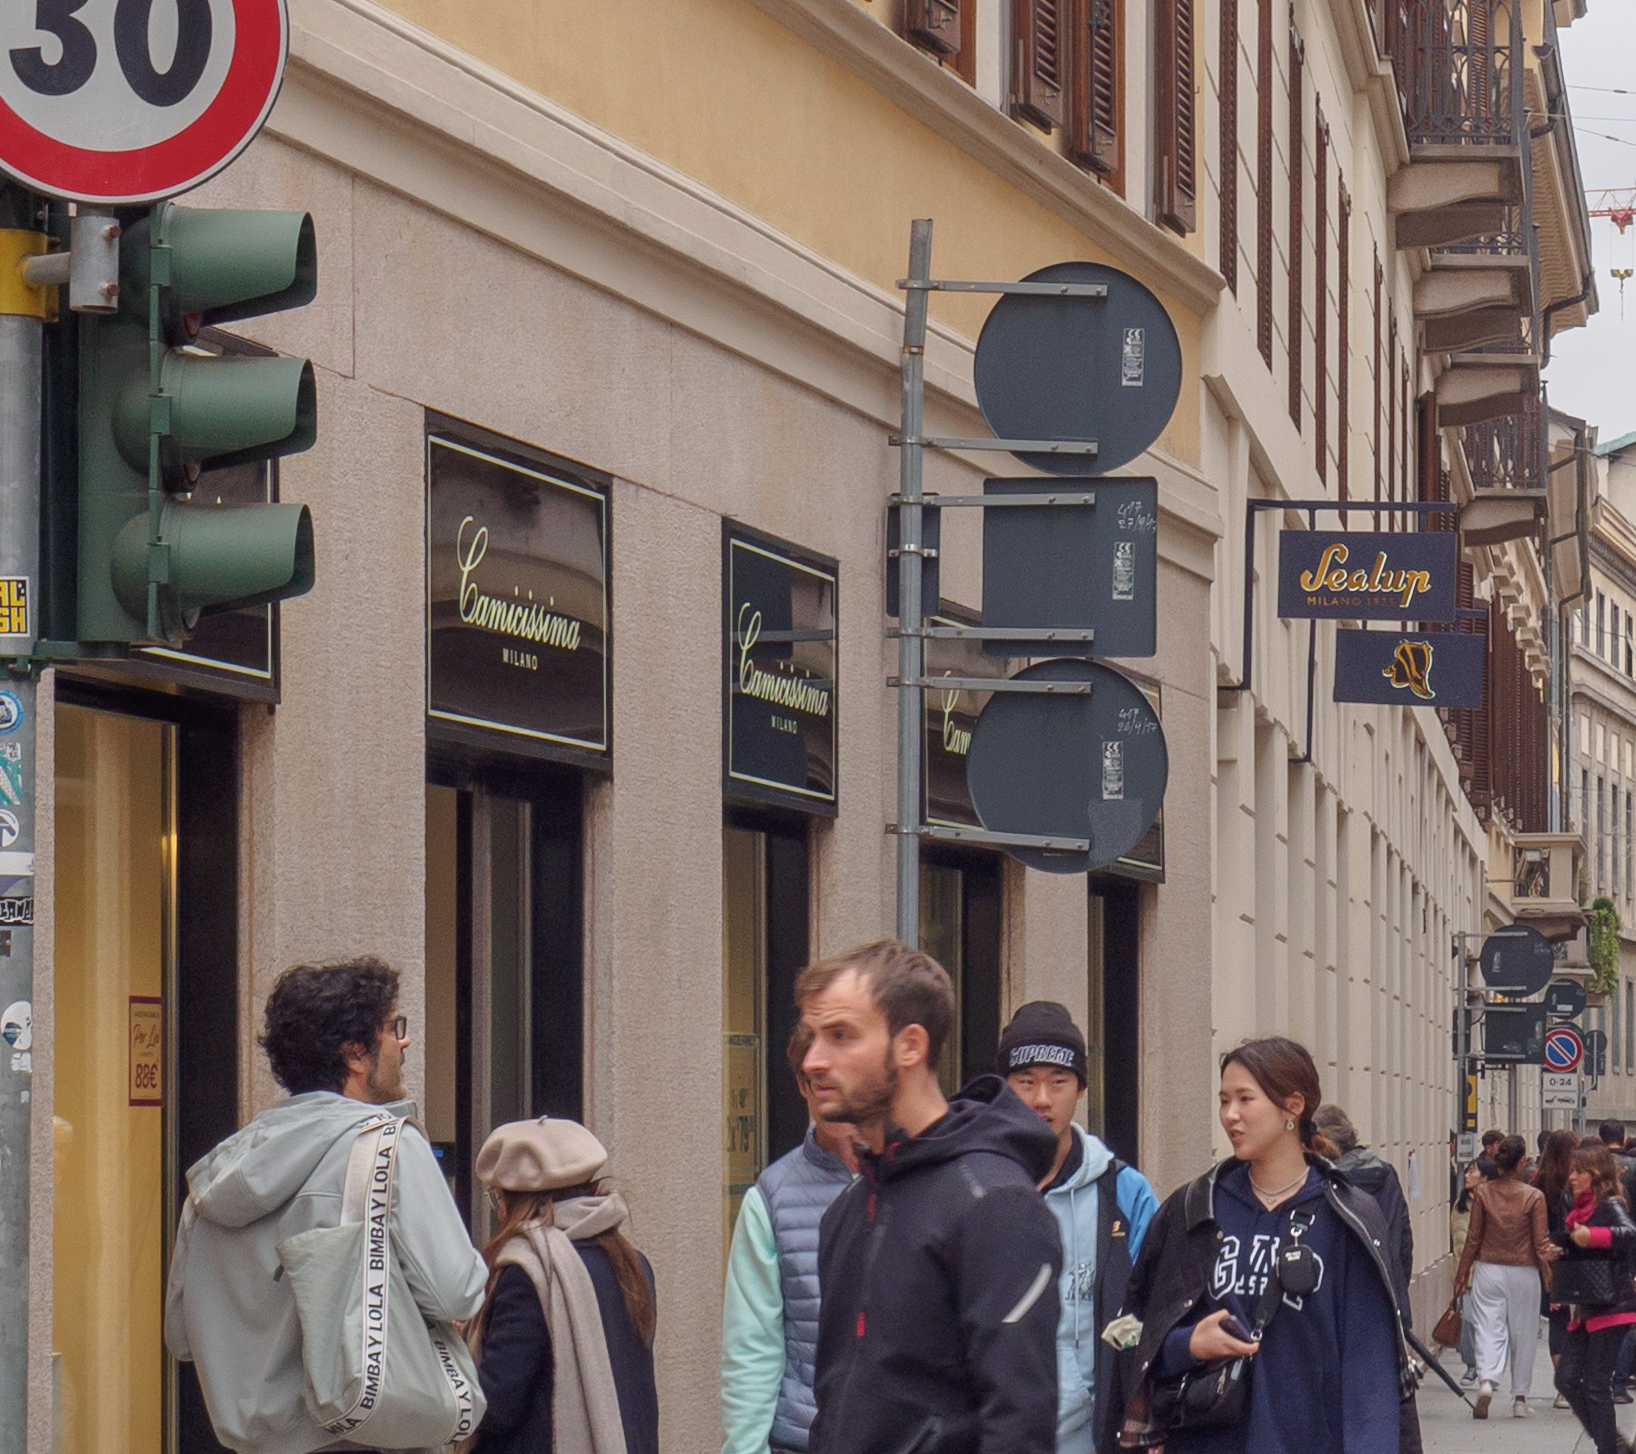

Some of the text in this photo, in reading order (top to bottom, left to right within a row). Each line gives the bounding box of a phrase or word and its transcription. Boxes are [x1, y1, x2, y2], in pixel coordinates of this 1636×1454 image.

[457, 516, 580, 650] Camicissima
[1300, 543, 1432, 608] Sealup
[1307, 597, 1362, 606] MILANO
[502, 648, 539, 670] MILANO
[738, 602, 829, 716] Camicissima
[771, 715, 798, 734] MILANO
[135, 1063, 159, 1089] 88€
[1009, 1045, 1075, 1066] SUPREME
[369, 1213, 387, 1271] BIMBA
[379, 1146, 393, 1194] LOLA
[368, 1283, 384, 1333] LOLA
[360, 1350, 383, 1410] BIMBA
